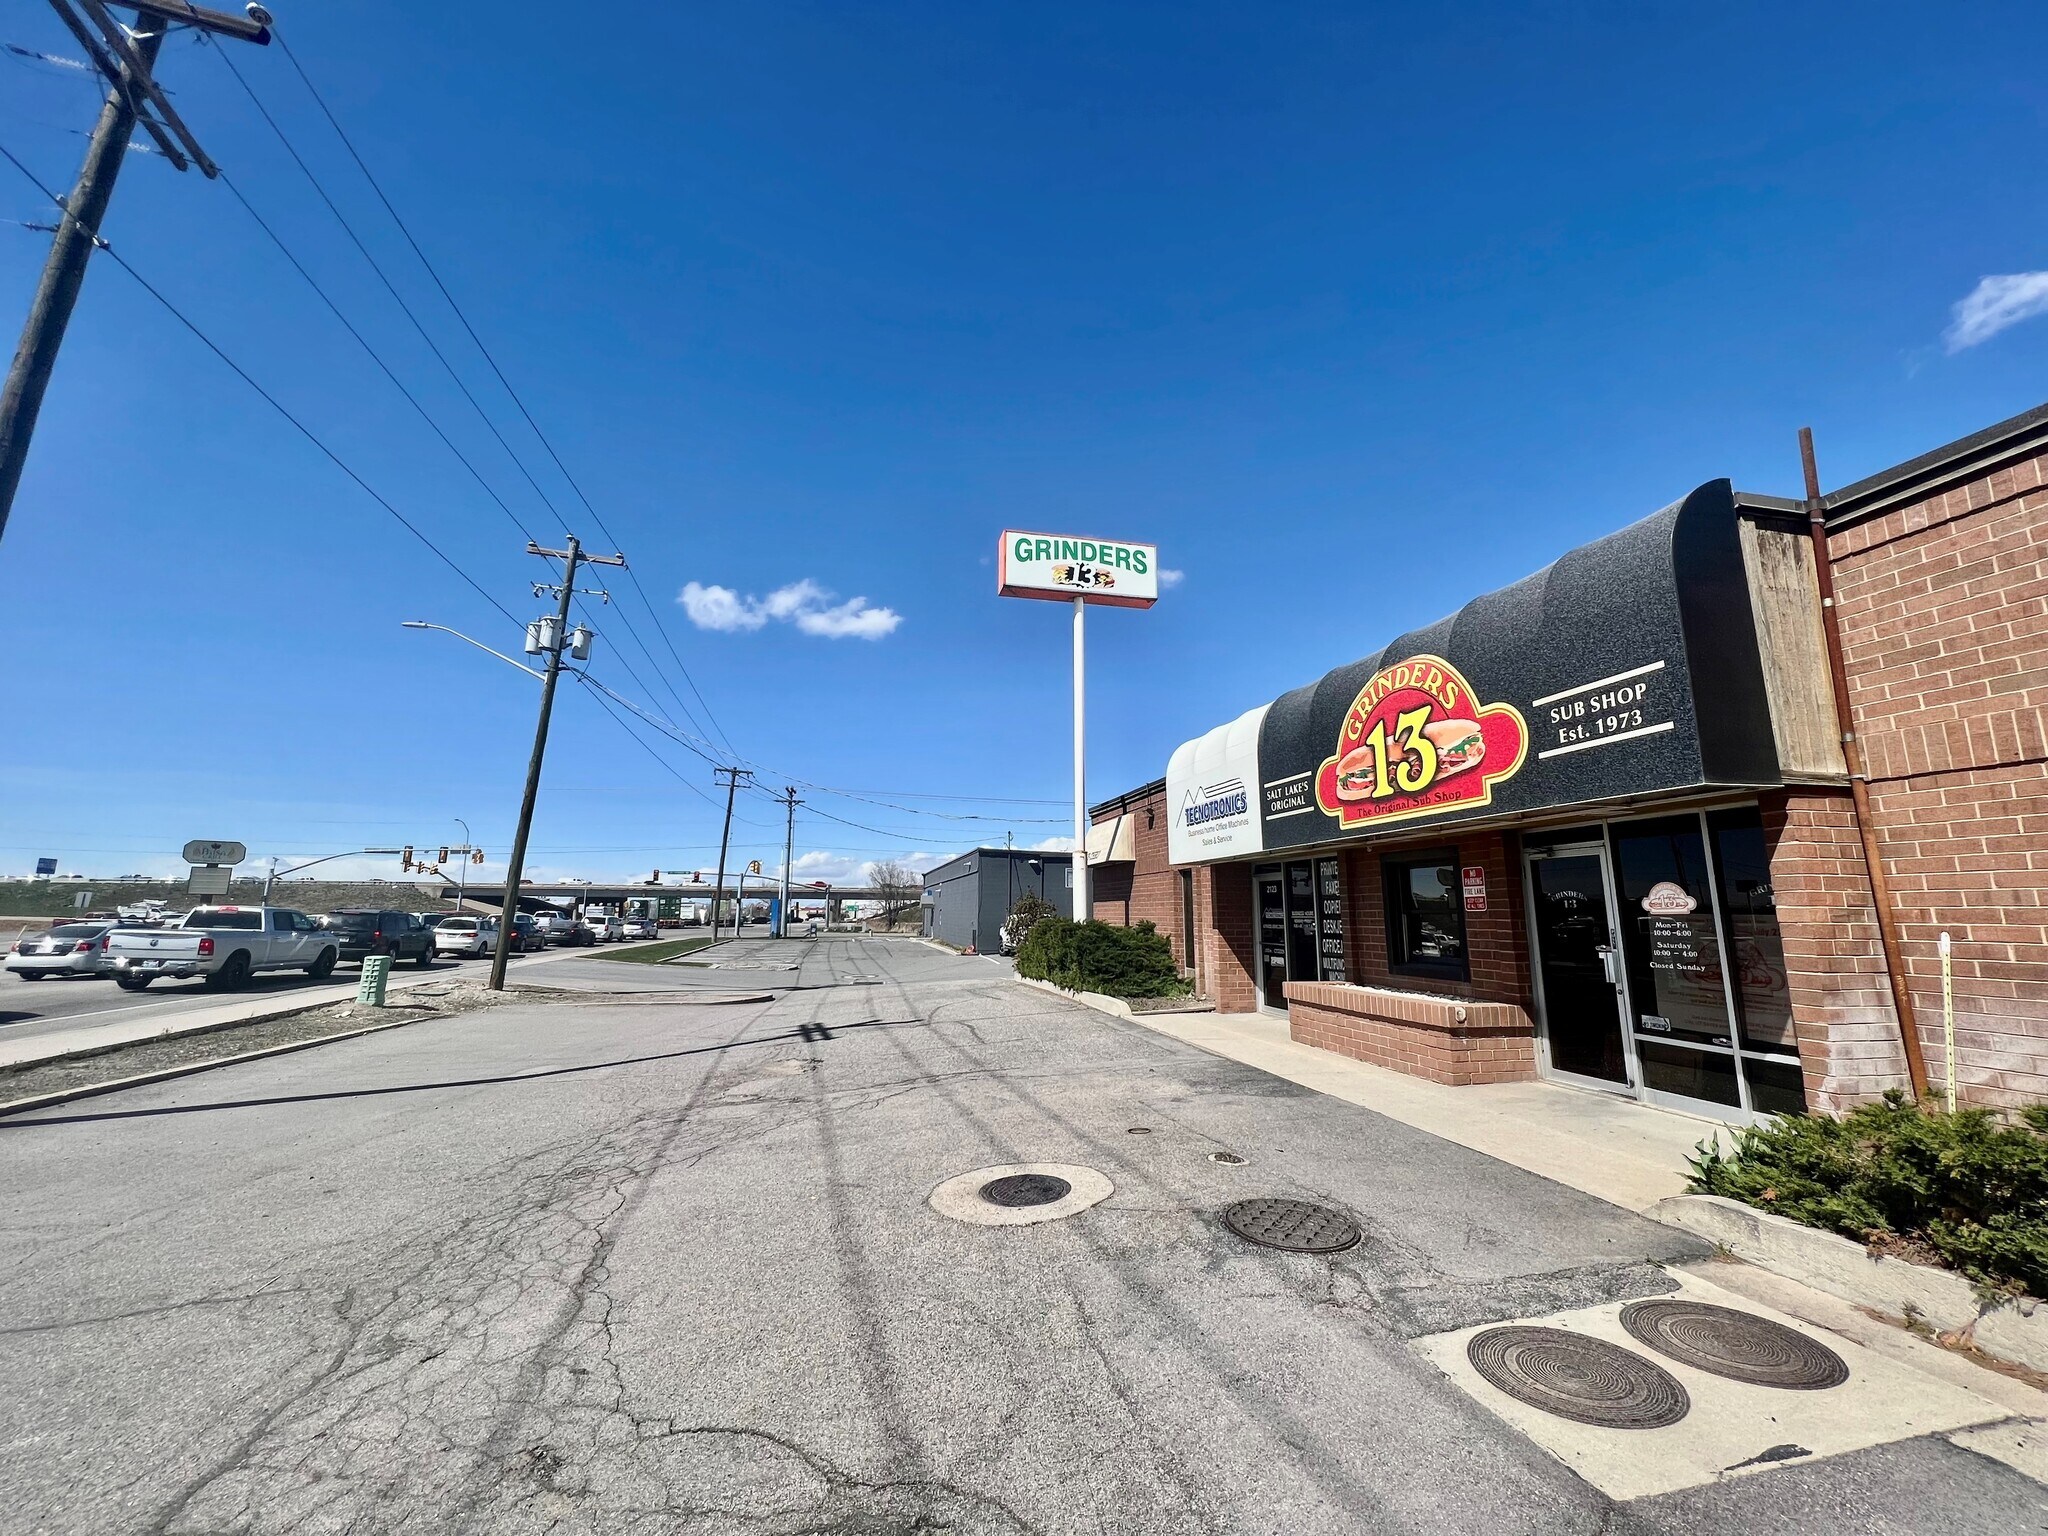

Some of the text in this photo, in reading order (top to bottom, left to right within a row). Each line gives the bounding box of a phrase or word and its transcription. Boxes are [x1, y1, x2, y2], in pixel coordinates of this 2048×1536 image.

[1014, 538, 1148, 575] GRINDERS
[1072, 563, 1097, 588] 13
[1347, 663, 1460, 741] GRINDERS
[1550, 683, 1647, 723] SUB SHOP
[1559, 709, 1642, 743] Est. 1973
[1366, 705, 1437, 799] 13
[1266, 781, 1309, 801] SALT LAKE'S
[1185, 791, 1248, 826] TECNOTRONICS
[1271, 795, 1306, 812] ORIGINAL
[1357, 790, 1462, 818] The Original Sub Shop
[1202, 836, 1213, 846] Sales
[1217, 834, 1233, 844] Service
[1564, 899, 1577, 908] 13
[1659, 893, 1676, 908] 13
[1653, 949, 1671, 957] 10:00
[1682, 950, 1698, 958] 4:00
[1656, 941, 1692, 950] Saturday
[1649, 961, 1706, 972] Closed Sunday
